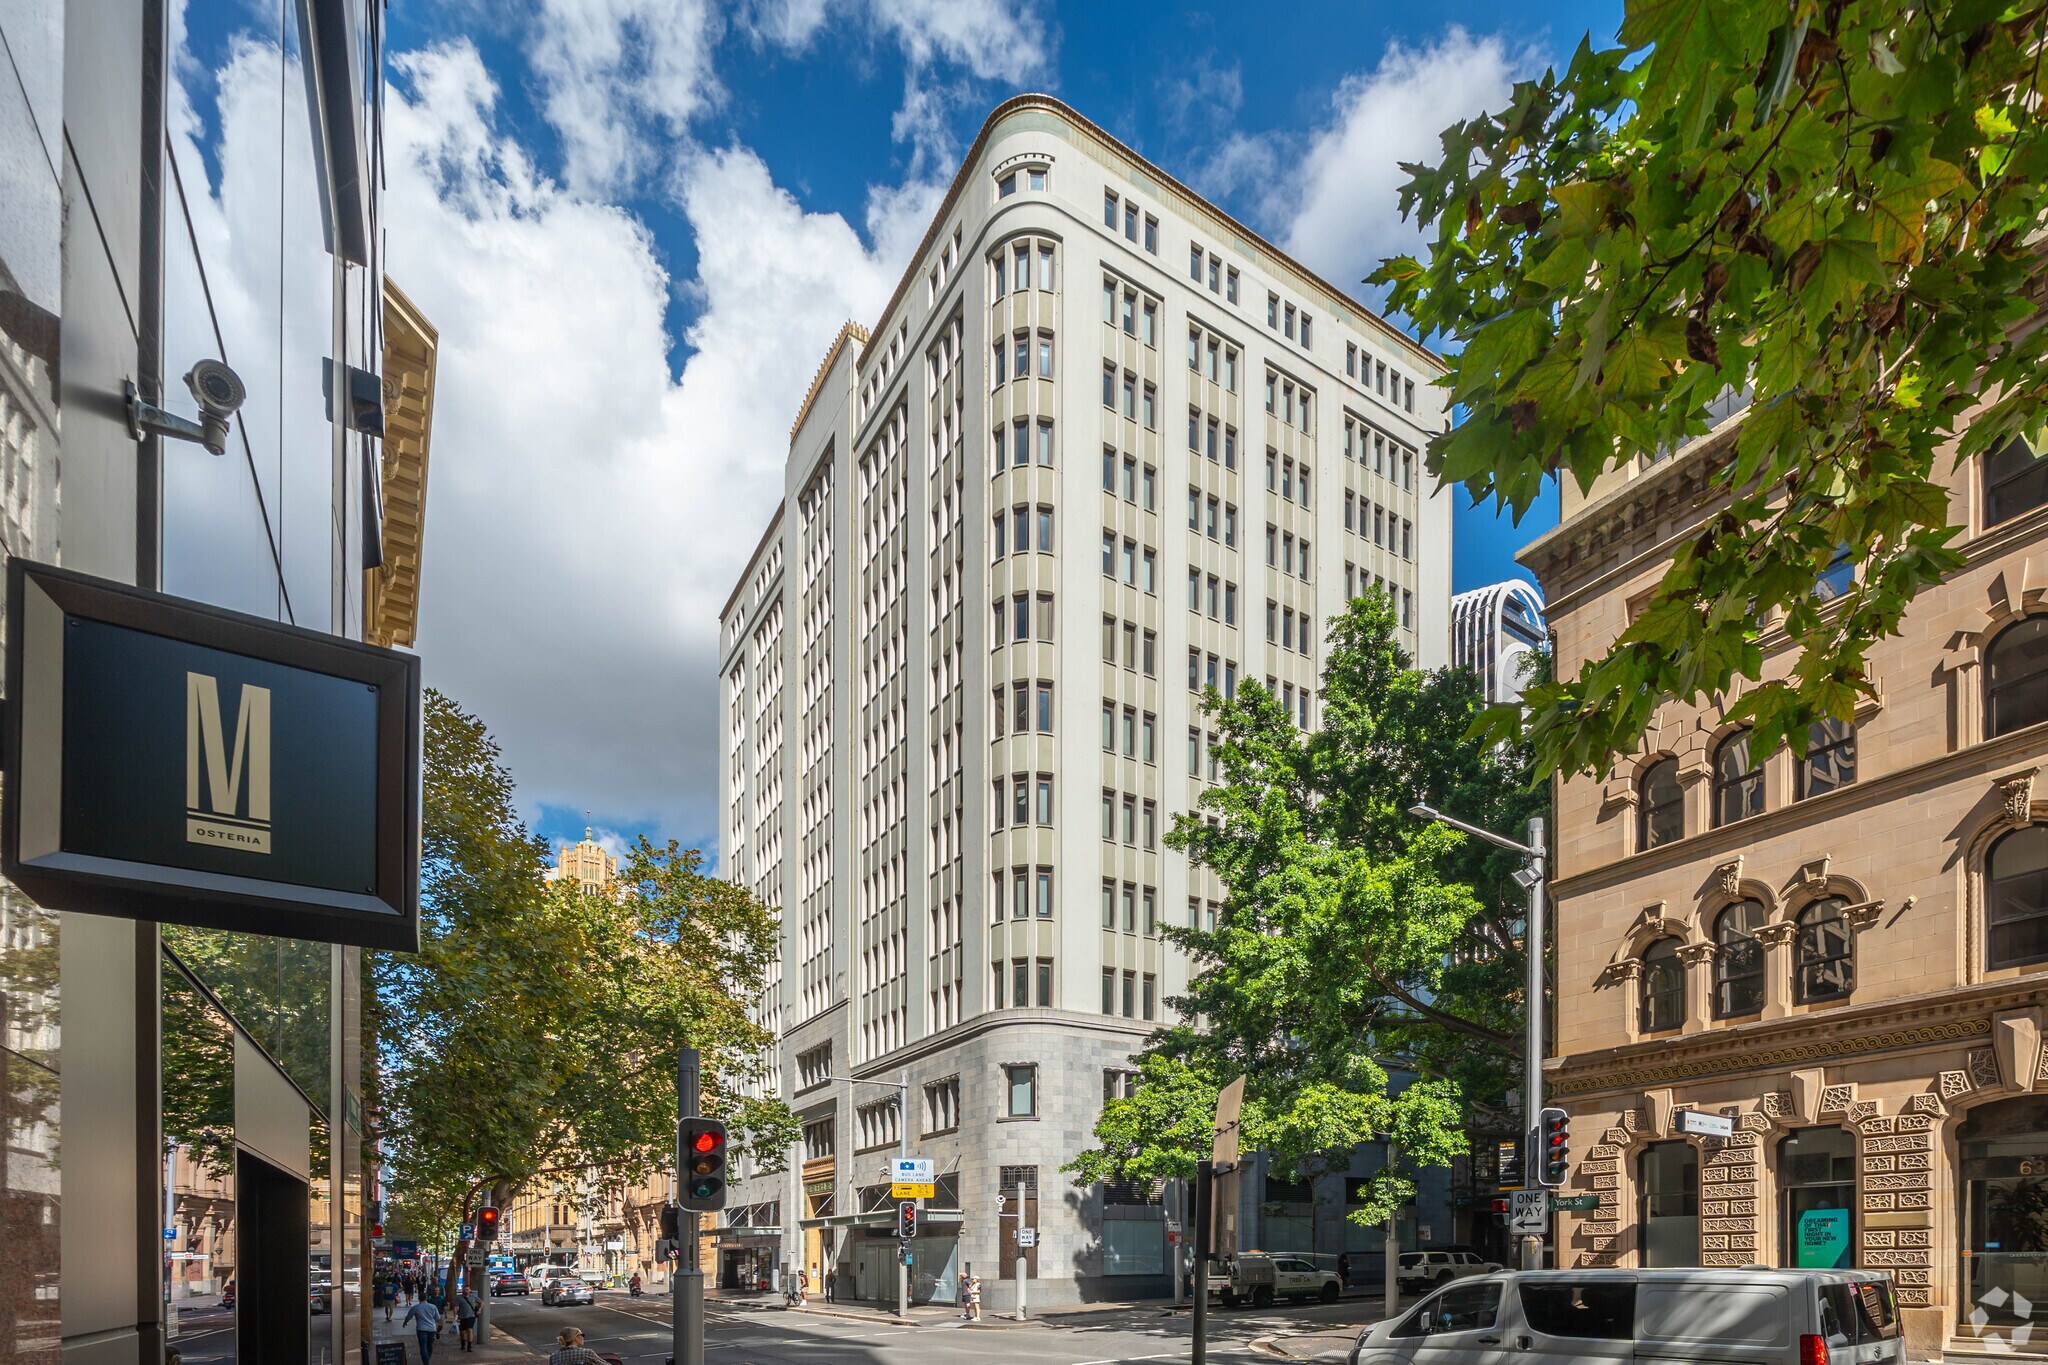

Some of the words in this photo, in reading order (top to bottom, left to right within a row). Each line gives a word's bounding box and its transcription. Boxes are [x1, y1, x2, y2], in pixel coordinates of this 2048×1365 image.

[187, 671, 271, 822] M
[196, 828, 261, 845] OSTERIA
[2020, 1160, 2046, 1175] 63
[1517, 1193, 1541, 1203] ONE
[1554, 1198, 1573, 1207] York
[1574, 1197, 1583, 1206] St
[1515, 1207, 1543, 1217] WAY
[463, 1225, 472, 1234] P
